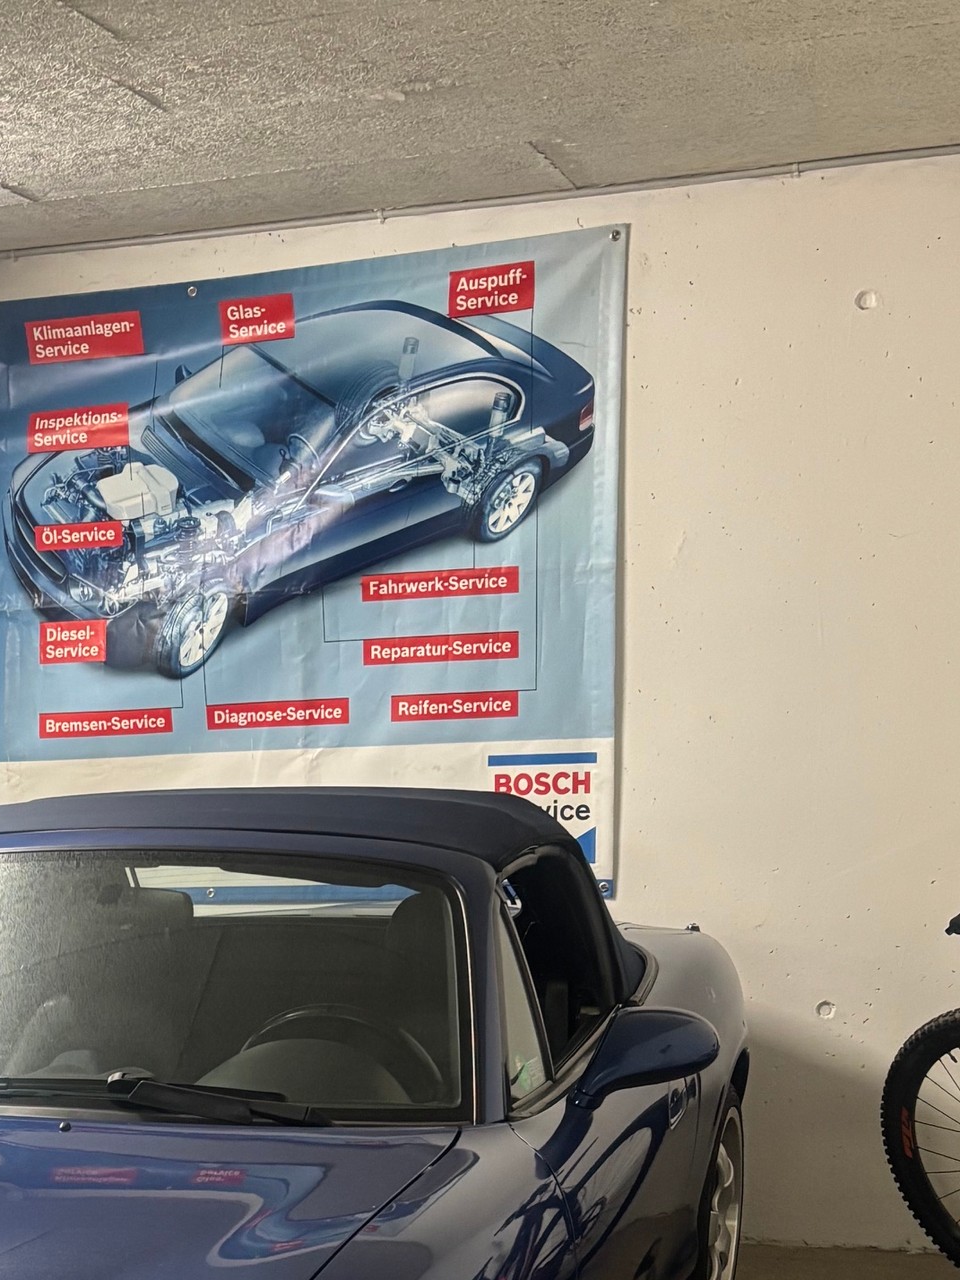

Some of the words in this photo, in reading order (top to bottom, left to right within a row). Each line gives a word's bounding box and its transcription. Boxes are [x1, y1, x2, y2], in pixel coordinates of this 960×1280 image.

[456, 268, 528, 292] Auspuff-
[456, 290, 519, 311] Service
[226, 304, 266, 321] Glas-
[32, 320, 135, 341] Klimaanlagen-
[228, 319, 287, 339] Service
[35, 340, 90, 358] Service
[34, 411, 123, 431] Inspektions-
[33, 429, 88, 447] Service
[41, 526, 116, 545] Öl-Service
[368, 575, 508, 596] Fahrwerk-Service
[45, 625, 95, 643] Diesel-
[45, 644, 99, 659] Service
[370, 638, 512, 660] Reparatur-Service
[213, 706, 343, 727] Diagnose-Service
[397, 696, 512, 717] Reifen-Service
[45, 714, 166, 733] Bremsen-Service
[494, 771, 591, 796] BOSCH
